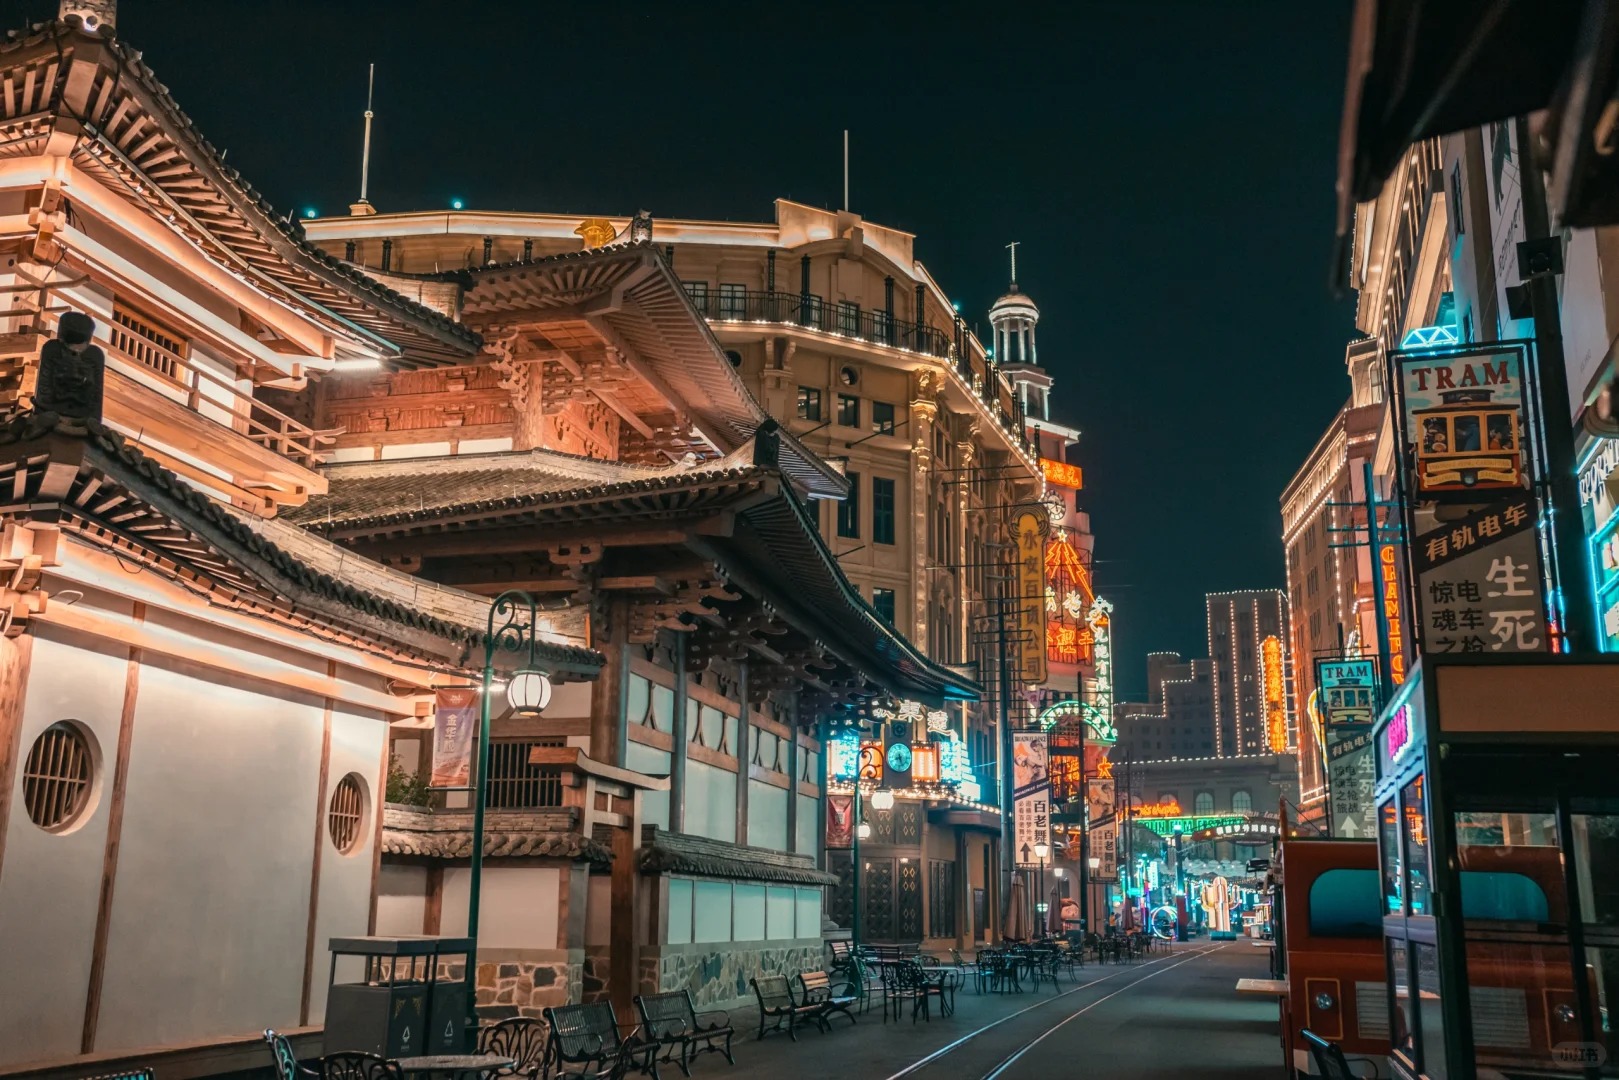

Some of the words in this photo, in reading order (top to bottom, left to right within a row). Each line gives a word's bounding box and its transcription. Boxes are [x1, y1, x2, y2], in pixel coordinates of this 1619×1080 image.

[1412, 361, 1510, 391] TRAM
[1426, 503, 1528, 561] 有轨电车
[1486, 556, 1540, 651] 生死
[1325, 665, 1368, 679] TRAM
